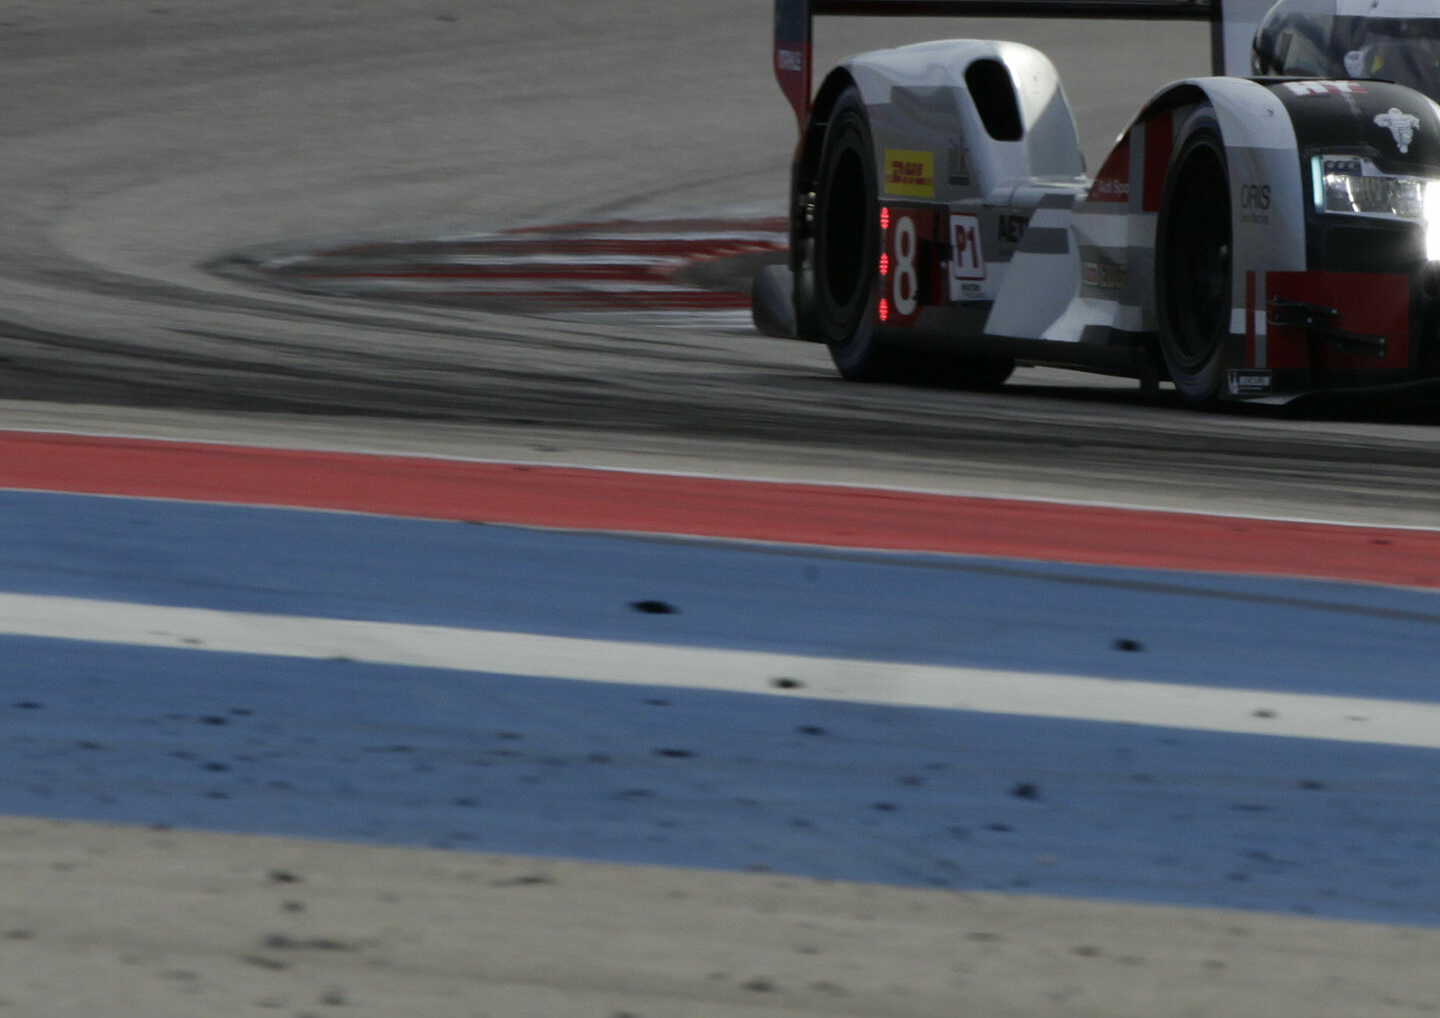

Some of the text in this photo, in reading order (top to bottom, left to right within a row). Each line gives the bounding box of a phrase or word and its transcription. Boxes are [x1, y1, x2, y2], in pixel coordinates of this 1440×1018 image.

[1240, 184, 1272, 210] ORIS
[893, 215, 918, 316] 8
[954, 224, 979, 269] P1
